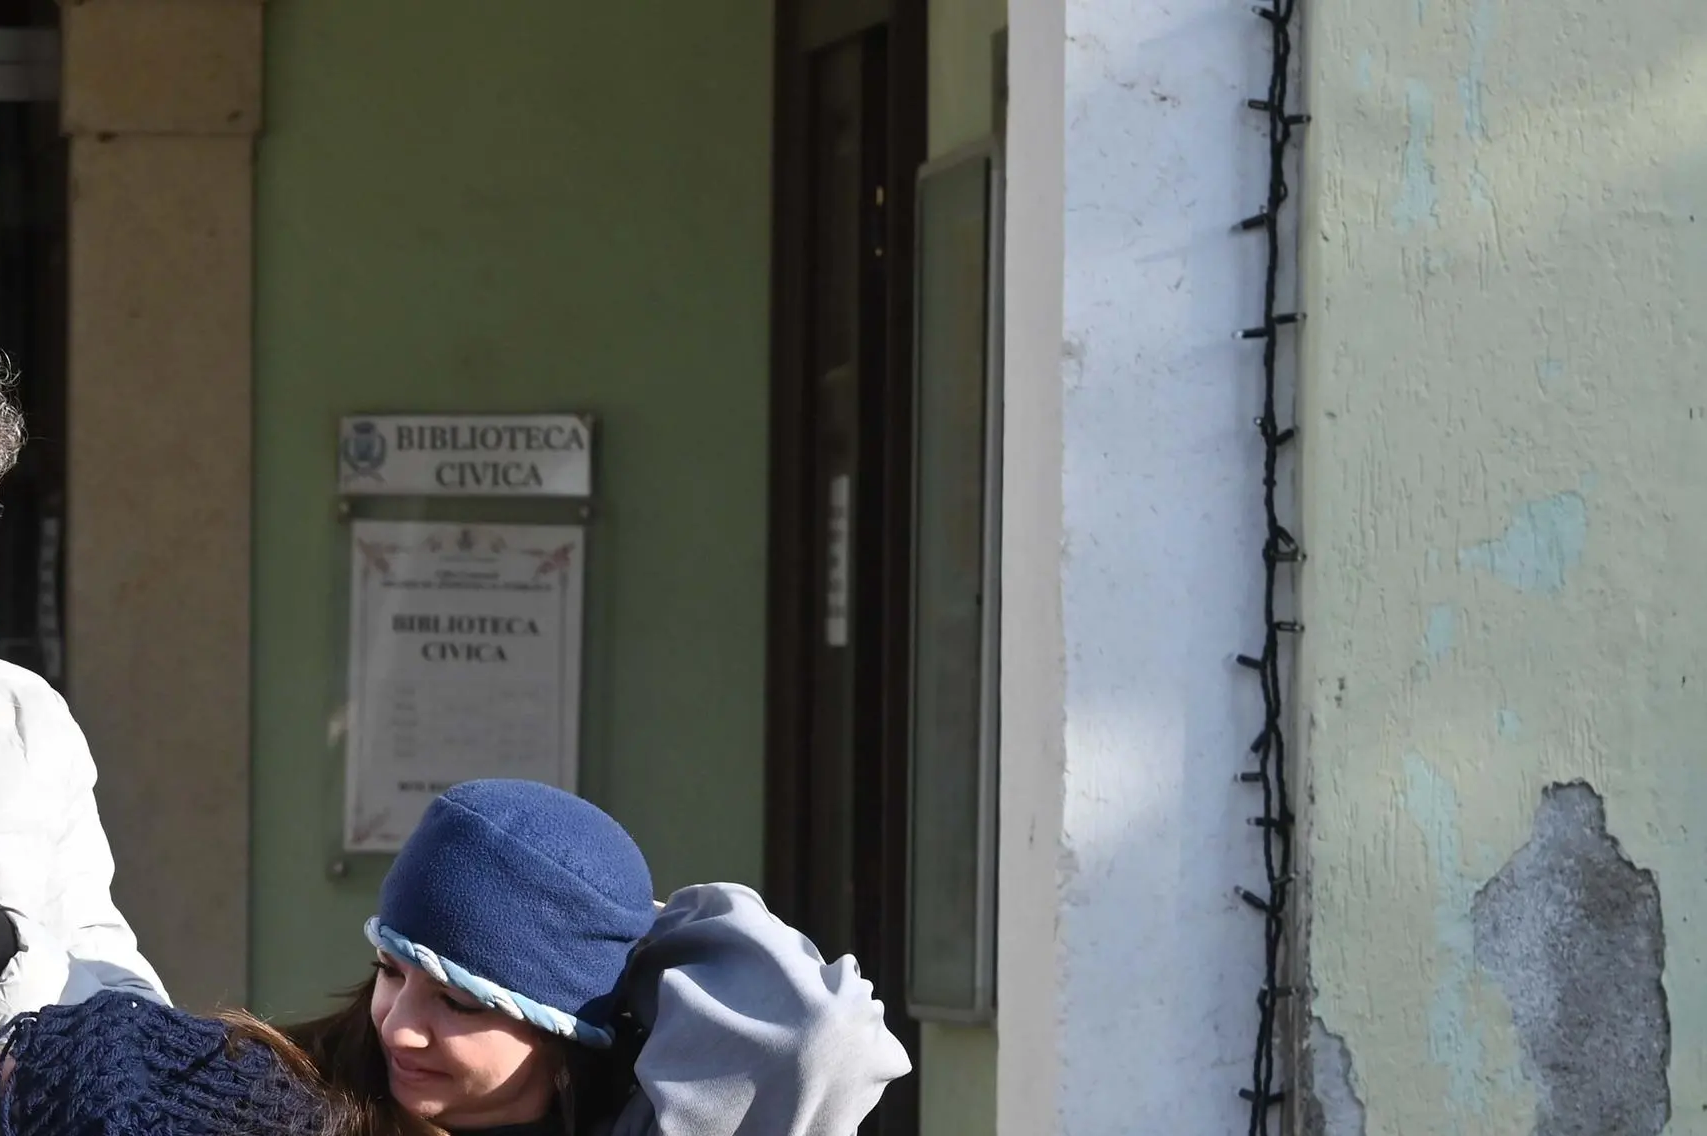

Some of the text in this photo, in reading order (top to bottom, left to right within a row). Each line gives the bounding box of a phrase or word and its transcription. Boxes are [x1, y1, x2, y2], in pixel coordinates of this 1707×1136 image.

[396, 424, 585, 451] BIBLIOTECA
[434, 461, 544, 488] CIVICA
[391, 614, 540, 637] BIBLIOTECA
[421, 641, 508, 663] CIVICA
